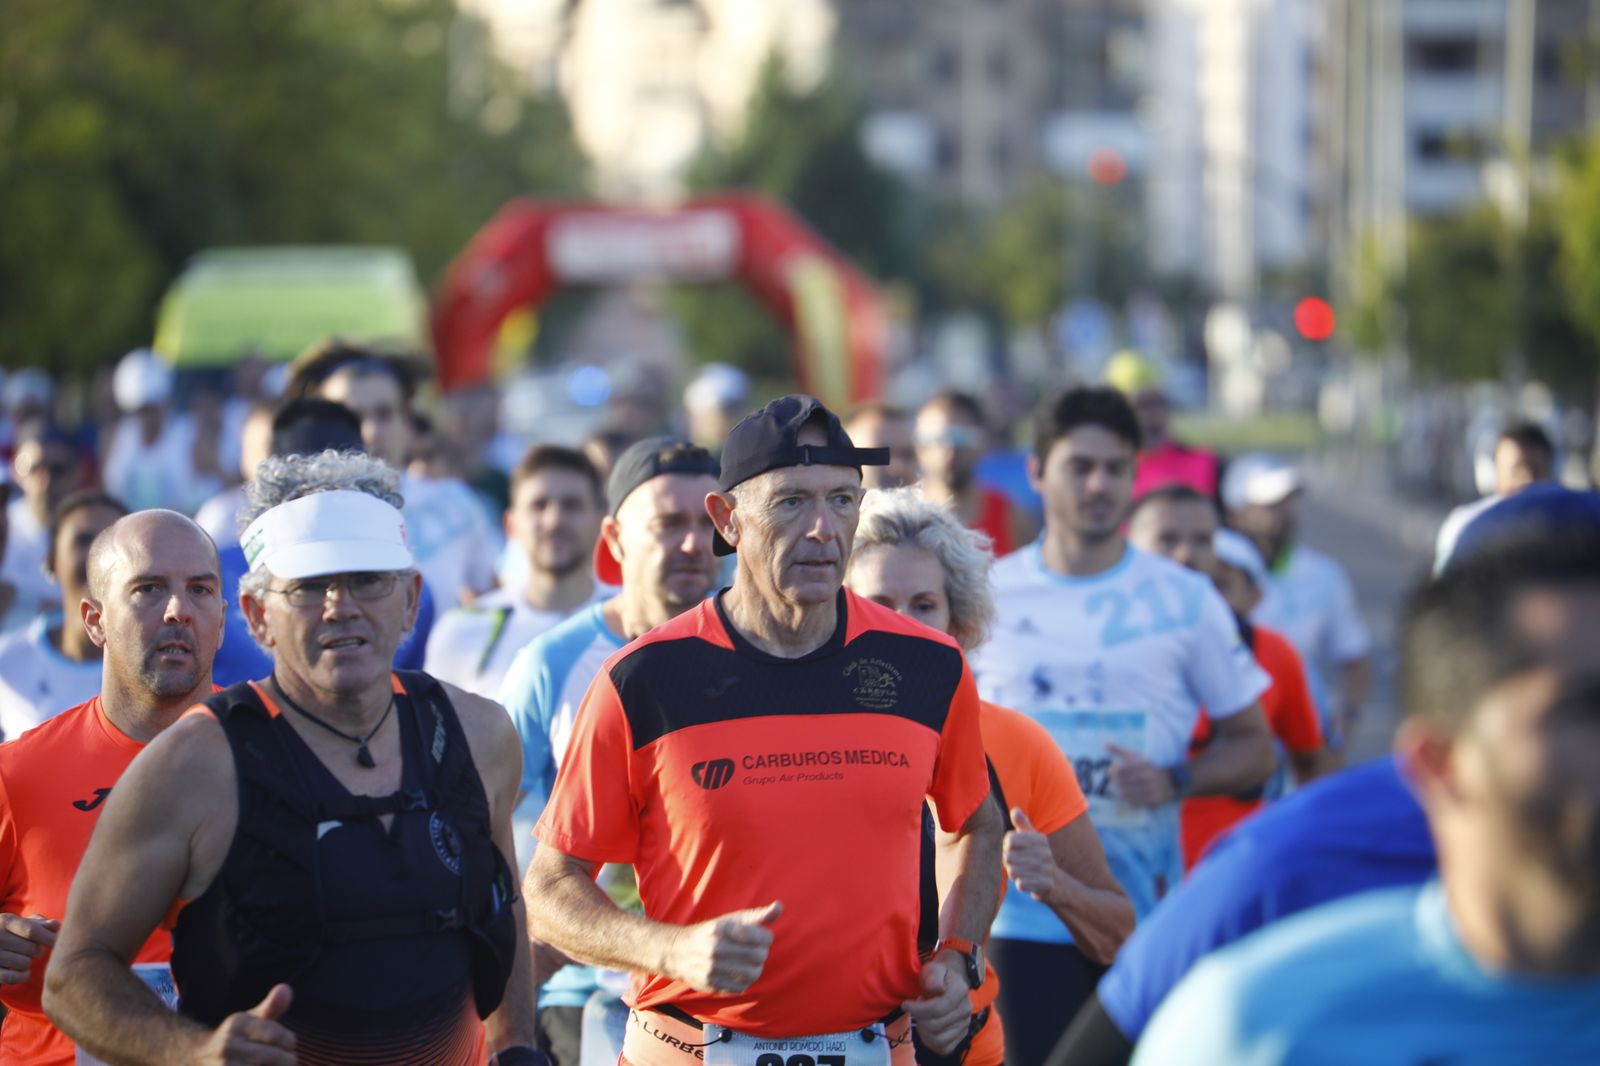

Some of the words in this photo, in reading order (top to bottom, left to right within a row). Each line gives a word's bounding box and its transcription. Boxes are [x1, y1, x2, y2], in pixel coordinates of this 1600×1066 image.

[742, 752, 842, 770] CARBUROS
[845, 750, 910, 768] MEDICA
[742, 775, 776, 786] Grupo
[779, 774, 794, 782] Air
[796, 772, 845, 782] Products
[643, 1021, 704, 1061] LURBE
[753, 1042, 788, 1051] ANTONIO
[789, 1042, 825, 1052] ROMERO
[826, 1042, 846, 1052] HARO
